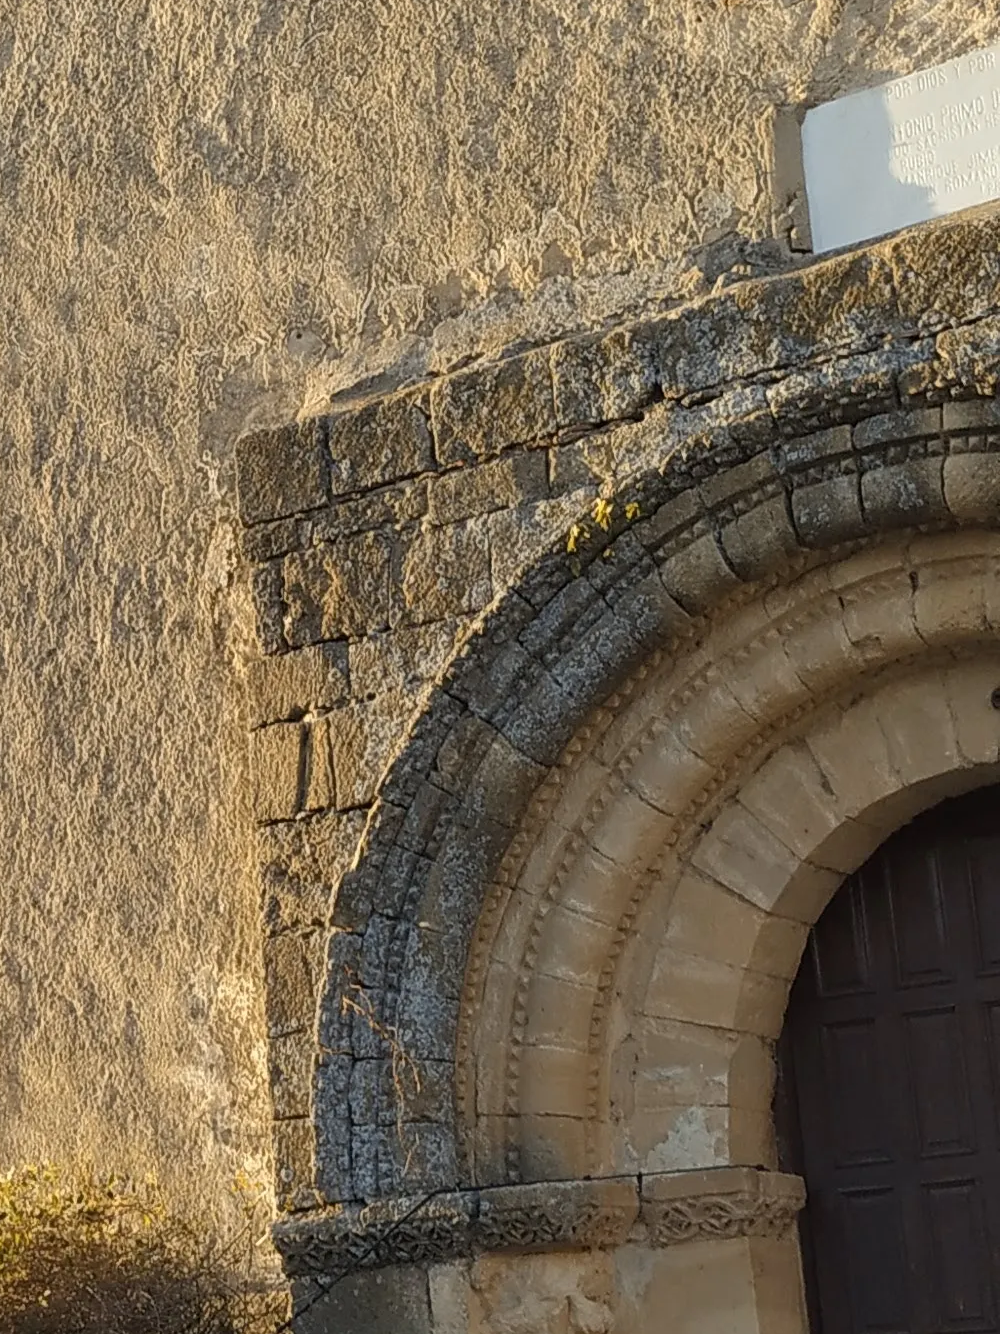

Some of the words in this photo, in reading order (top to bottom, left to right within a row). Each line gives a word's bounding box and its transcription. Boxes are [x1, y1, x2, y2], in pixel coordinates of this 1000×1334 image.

[886, 80, 913, 102] POR
[917, 69, 947, 92] DIOS
[953, 62, 961, 79] Y
[968, 52, 997, 75] POR
[941, 96, 985, 126] PRIMO
[900, 150, 935, 175] RUBIO
